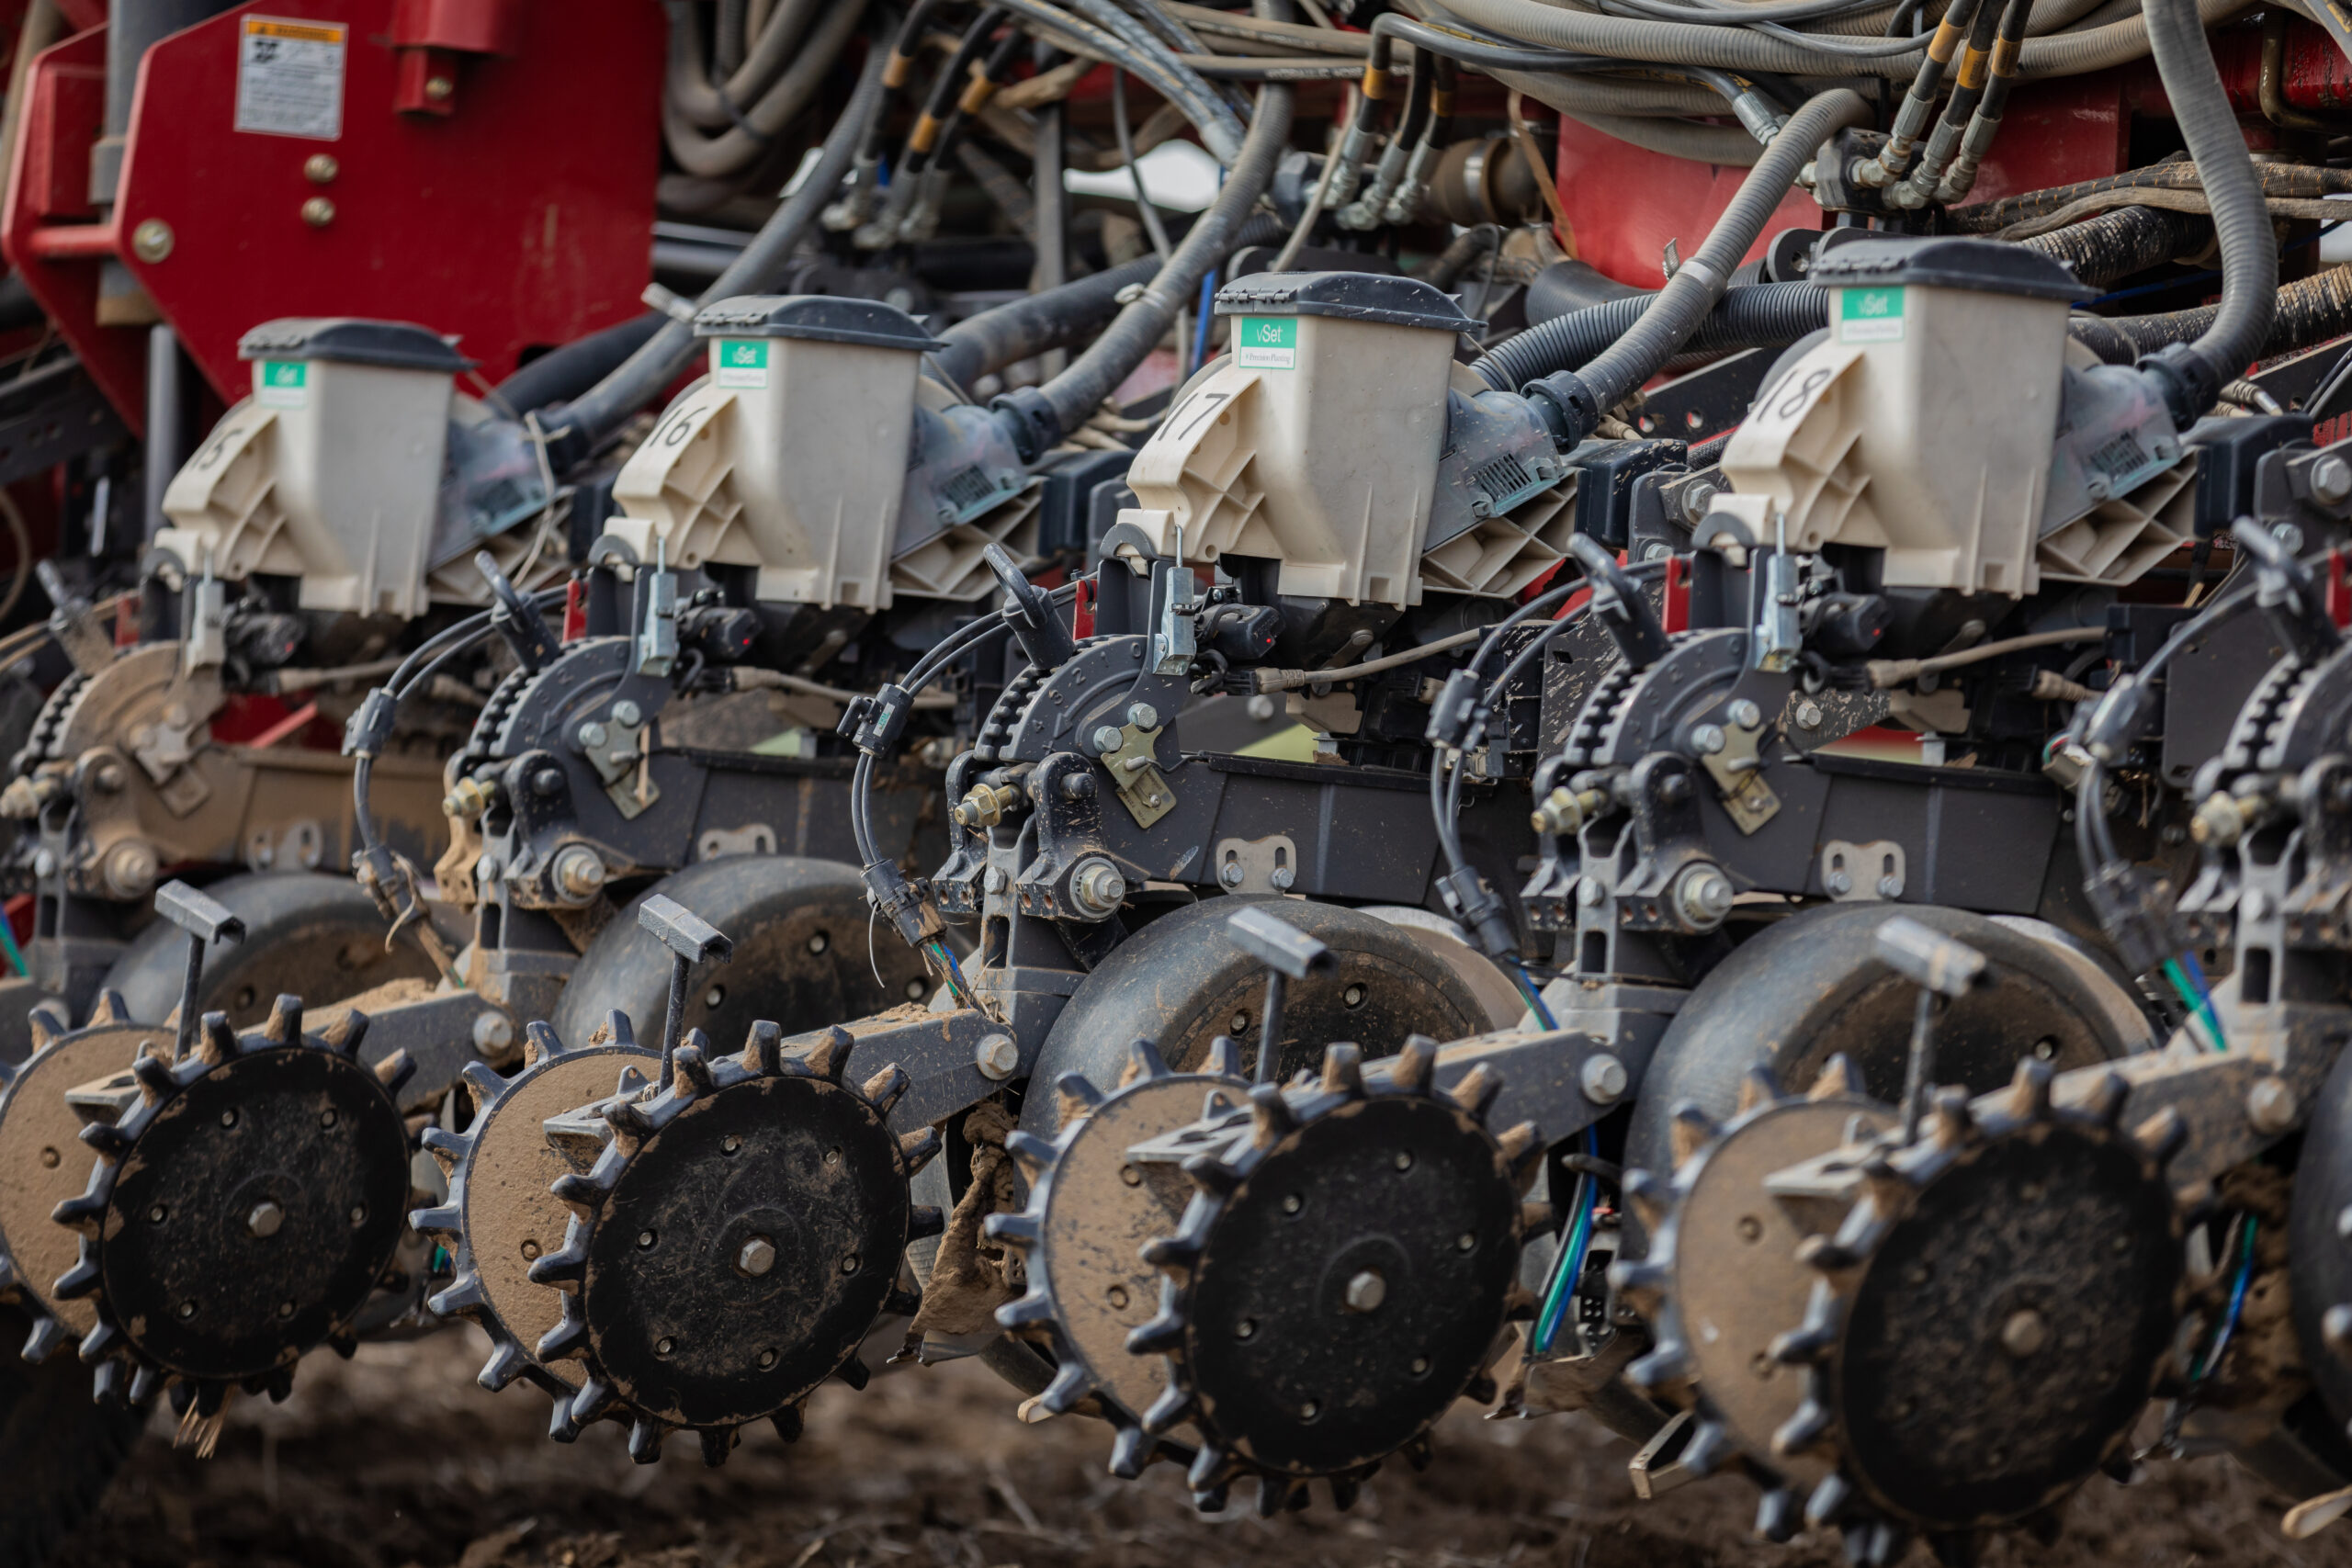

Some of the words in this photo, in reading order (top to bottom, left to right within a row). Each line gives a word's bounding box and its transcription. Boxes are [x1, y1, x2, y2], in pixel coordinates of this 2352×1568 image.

[1256, 323, 1283, 344] vSet
[1757, 369, 1831, 422] 18
[649, 406, 708, 447] 16
[1158, 392, 1231, 442] 17
[1071, 667, 1087, 685] 2
